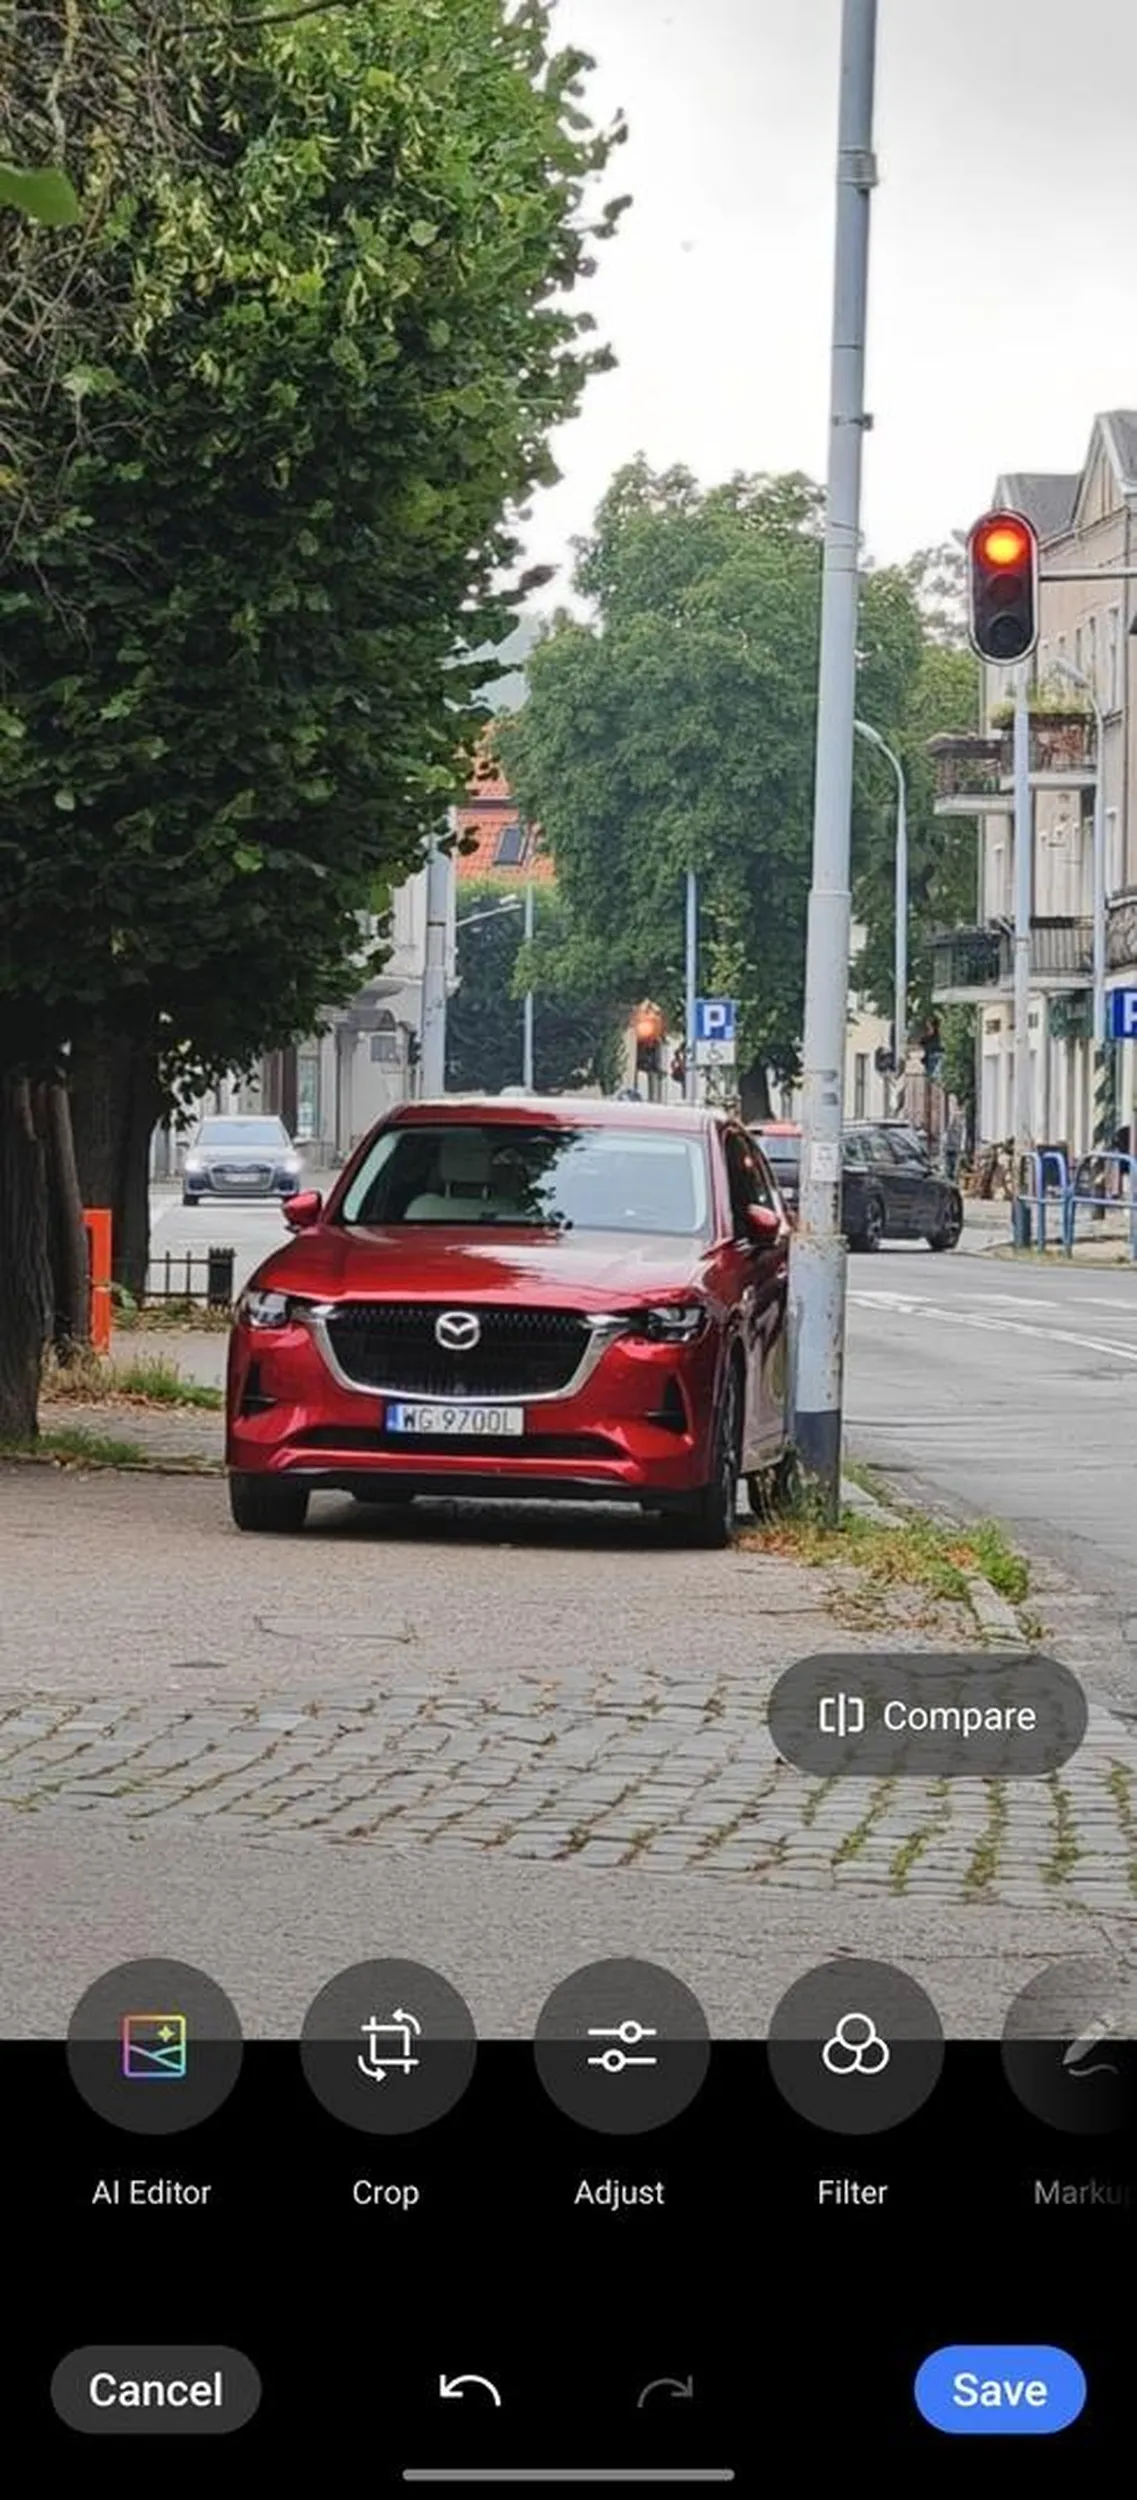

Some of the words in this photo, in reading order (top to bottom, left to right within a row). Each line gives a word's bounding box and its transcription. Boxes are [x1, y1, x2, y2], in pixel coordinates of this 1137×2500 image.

[703, 1004, 726, 1037] P
[402, 1408, 434, 1430] WG
[442, 1409, 515, 1433] 9700L
